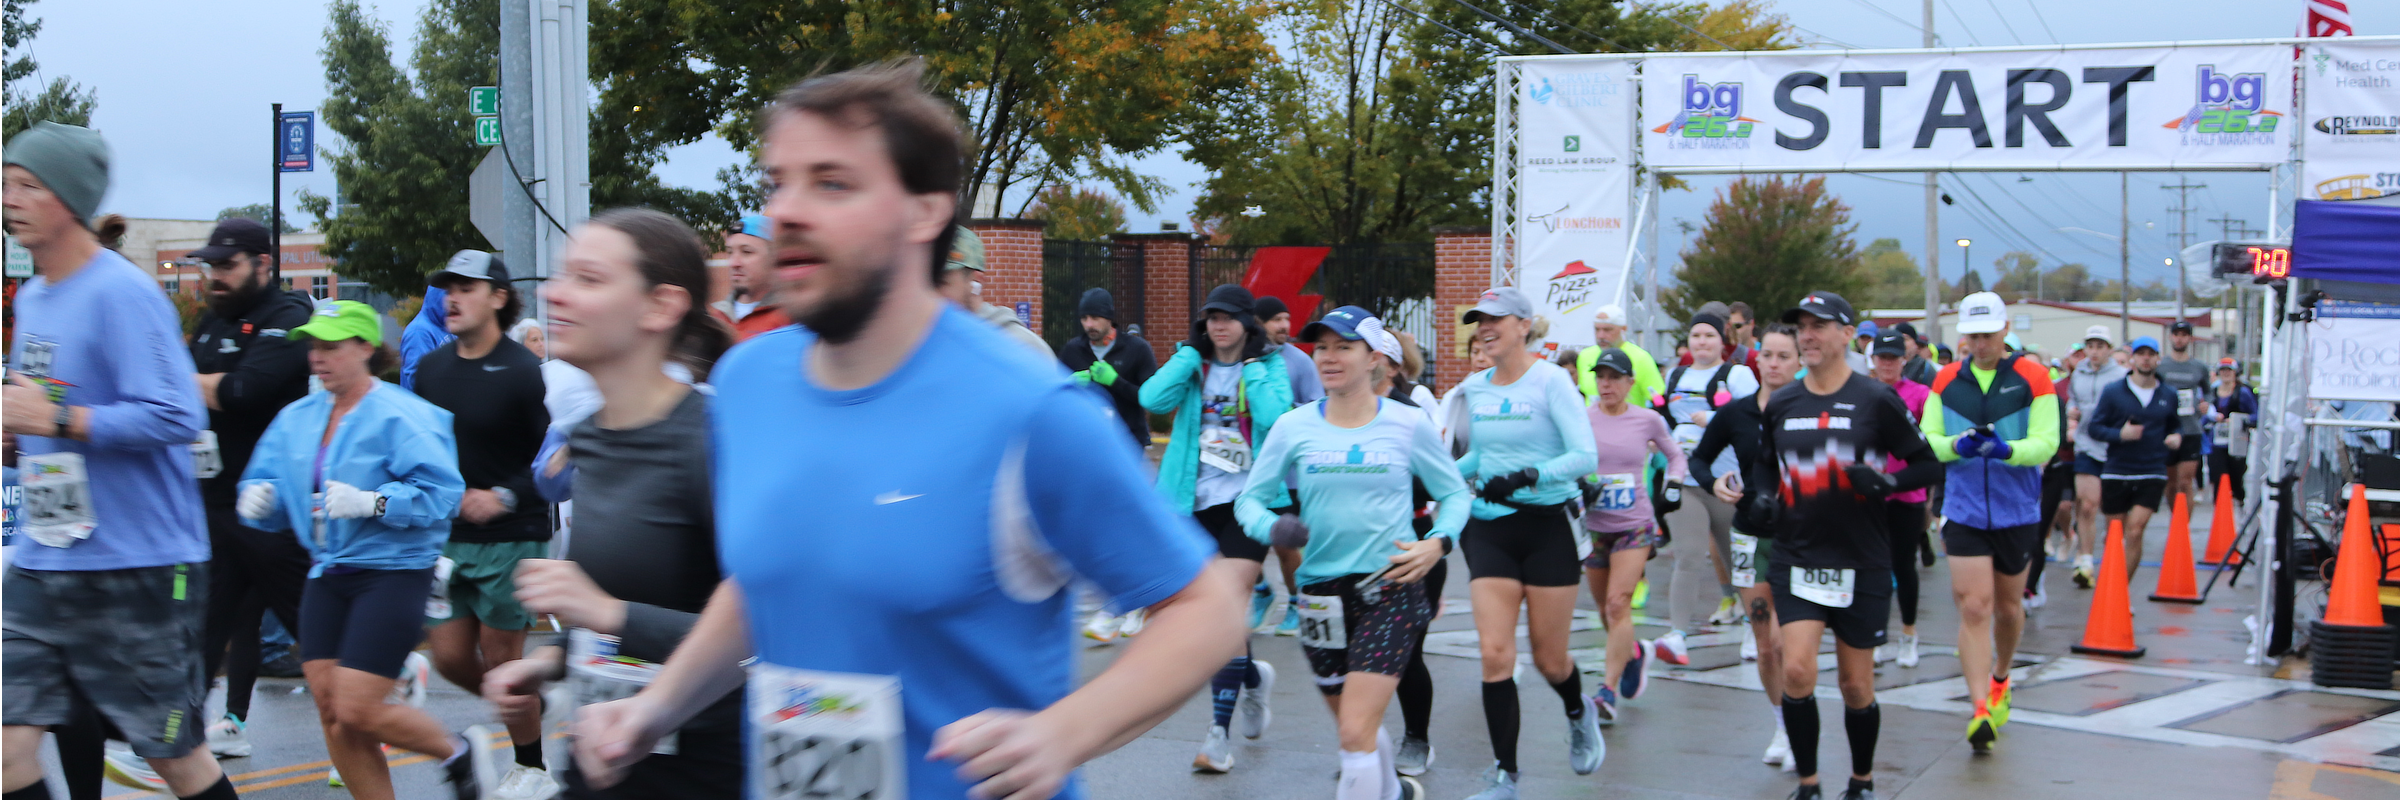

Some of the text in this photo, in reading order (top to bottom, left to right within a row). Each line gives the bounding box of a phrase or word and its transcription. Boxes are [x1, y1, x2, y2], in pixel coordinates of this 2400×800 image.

[2335, 58, 2371, 72] Med
[1555, 72, 1613, 84] GRAVES
[2335, 75, 2391, 88] Health
[1556, 83, 1620, 95] GILBERT
[1682, 73, 1744, 121] bg
[2195, 64, 2266, 116] bg
[473, 91, 483, 112] E
[1556, 95, 1609, 107] CLINIC
[1773, 65, 2155, 151] START
[1682, 116, 1754, 138] 26.2
[2196, 109, 2278, 133] 26.2
[480, 120, 501, 142] CE
[2191, 134, 2215, 146] HALF
[2217, 133, 2275, 146] MARATHON
[1677, 137, 1699, 150] HALF
[1701, 137, 1750, 150] MARATHON
[1528, 157, 1555, 165] REED
[1581, 156, 1617, 164] GROUP
[1555, 216, 1622, 229] LONGHORN
[1546, 274, 1599, 304] Pizza
[1555, 290, 1594, 311] Hut
[1783, 411, 1852, 431] IRONMAN
[1803, 567, 1843, 586] 864
